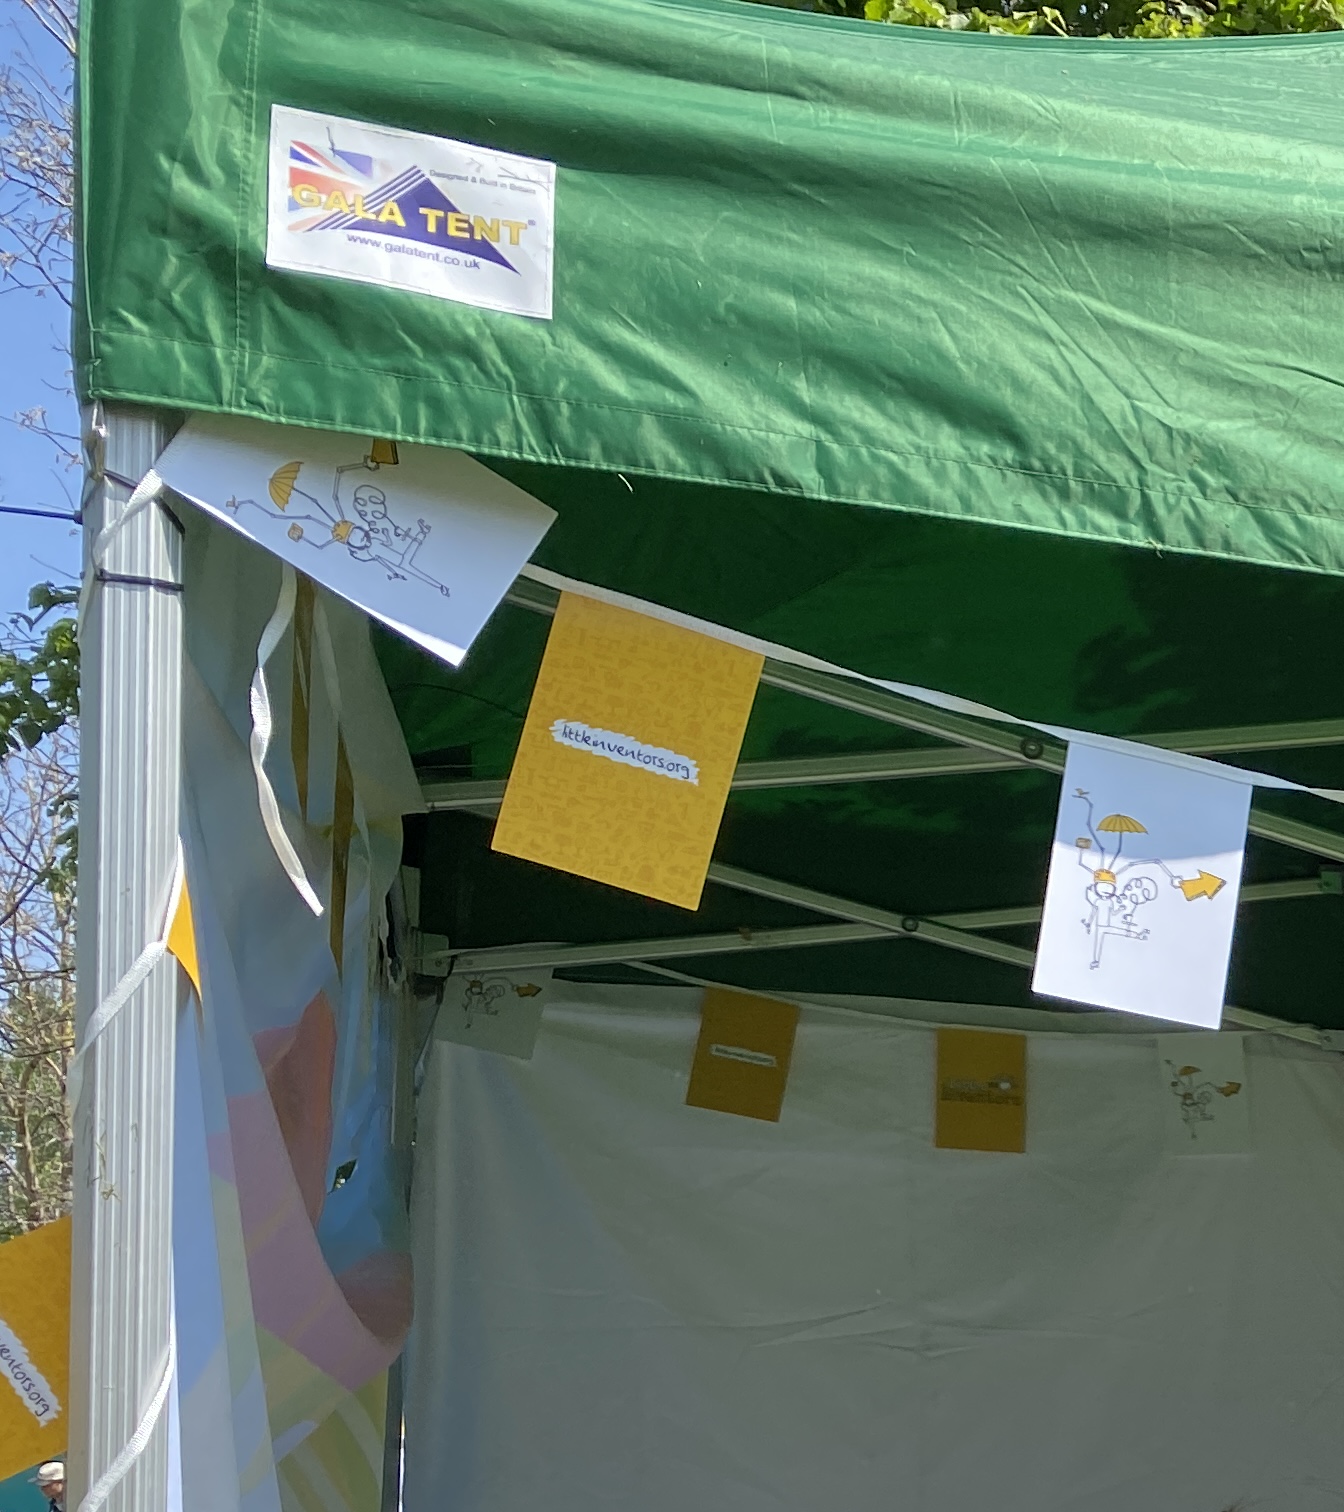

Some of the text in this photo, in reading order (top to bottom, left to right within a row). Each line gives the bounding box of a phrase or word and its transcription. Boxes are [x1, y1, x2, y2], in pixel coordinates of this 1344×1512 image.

[291, 183, 528, 246] GALA TENT
[347, 232, 481, 270] www.galatent.co.uk
